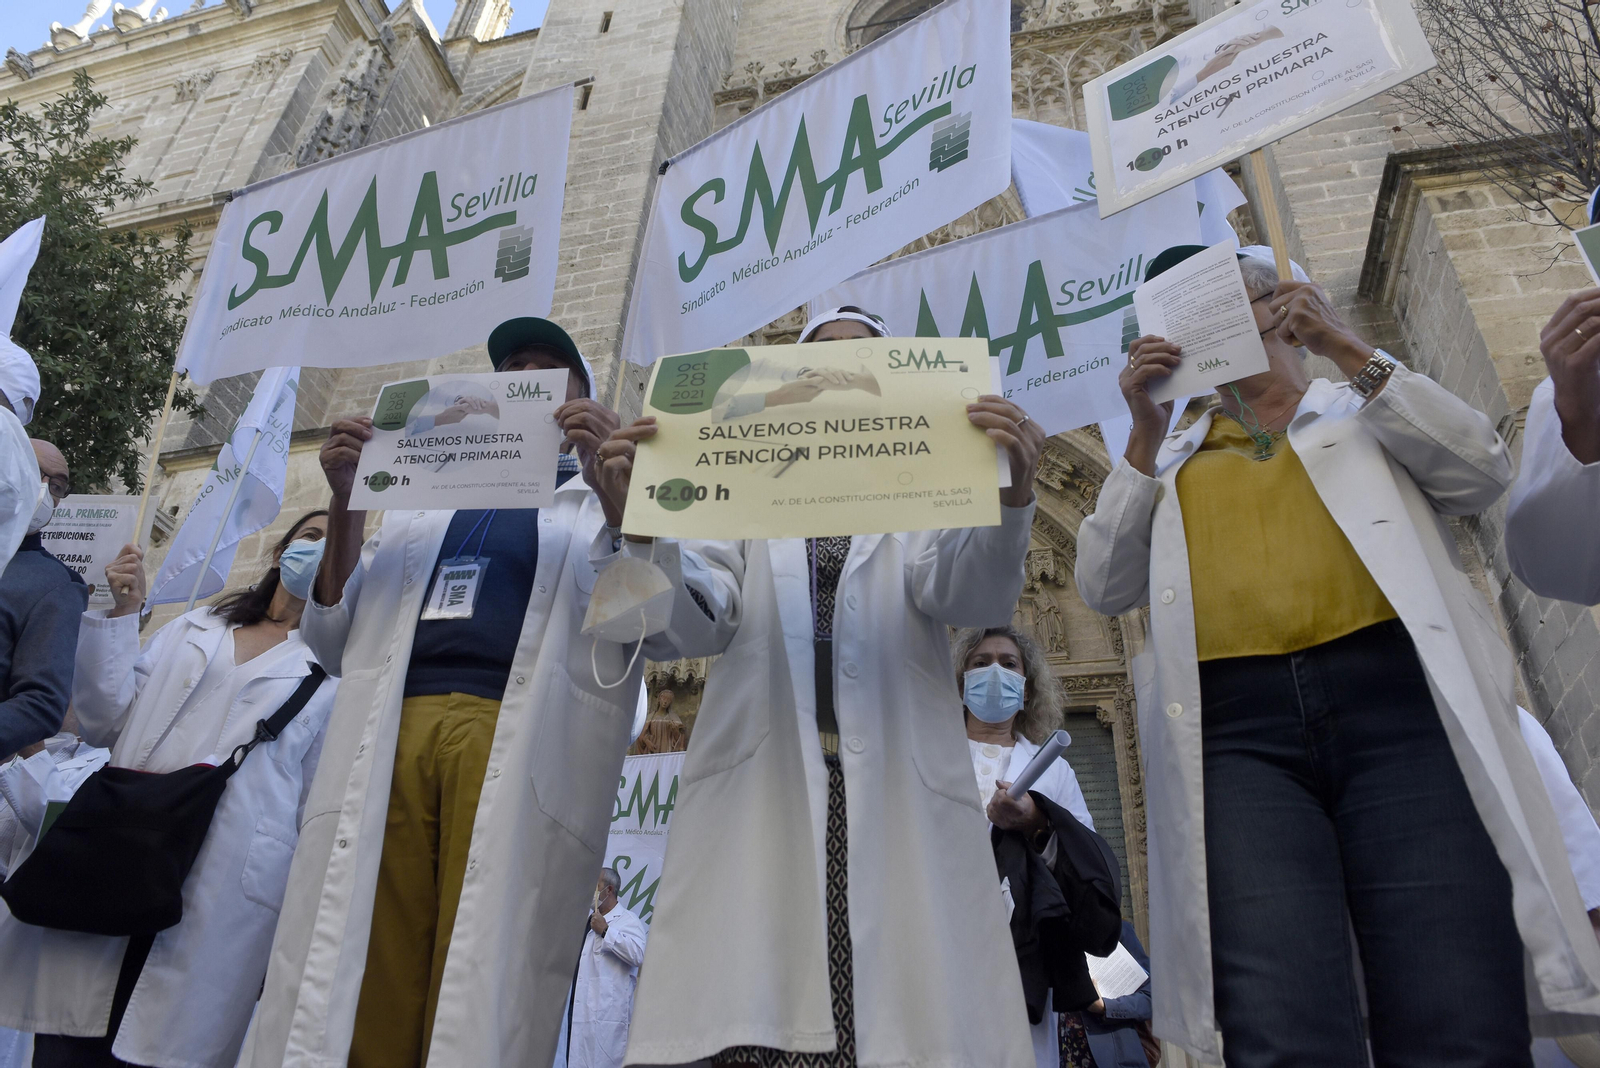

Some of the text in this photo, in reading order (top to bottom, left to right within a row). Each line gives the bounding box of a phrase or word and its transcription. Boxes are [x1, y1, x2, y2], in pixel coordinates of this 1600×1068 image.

[1123, 75, 1146, 91] Oct
[1154, 32, 1328, 124] SALVEMOS NUESTRA
[1344, 65, 1376, 83] SEVILLA
[879, 63, 977, 138] Sevilla
[1124, 83, 1148, 101] 28
[1157, 46, 1333, 138] ATENCIÓN PRIMARIA
[1233, 120, 1243, 129] DE
[1244, 115, 1254, 124] LA
[1255, 90, 1310, 118] CONSTITUCION
[1311, 73, 1343, 94] (FRENTE
[1344, 67, 1356, 75] AL
[1126, 94, 1151, 110] 2021
[1126, 138, 1188, 172] 12.00 h
[446, 171, 538, 223] Sevilla
[677, 93, 884, 283] SMA
[227, 170, 450, 310] SMA
[680, 279, 726, 315] Sindicato
[732, 253, 779, 285] Médico
[783, 228, 834, 263] Andaluz
[845, 177, 920, 229] Federación
[220, 312, 273, 341] Sindicato
[279, 302, 335, 320] Médico
[338, 301, 397, 318] Andaluz
[410, 279, 485, 308] Federación
[678, 361, 709, 373] Oct
[888, 347, 947, 371] SMA
[1197, 357, 1221, 372] SMA
[674, 373, 706, 388] 28
[1027, 356, 1110, 391] Federación
[507, 381, 540, 399] SMA
[671, 390, 704, 400] 2021
[386, 400, 404, 411] 28
[383, 411, 402, 420] 2021
[698, 415, 930, 440] SALVEMOS NUESTRA
[397, 433, 523, 449] SALVEMOS NUESTRA
[393, 449, 522, 465] ATENCIÓN PRIMARIA
[695, 441, 931, 467] ATENCIÓN PRIMARIA
[362, 475, 410, 486] 12.00 h
[645, 484, 730, 502] 12.00 h
[804, 497, 817, 505] LA
[818, 493, 890, 504] CONSTITUCION
[892, 490, 934, 501] (FRENTE
[950, 487, 972, 496] SAS)
[933, 498, 973, 508] SEVILLA
[76, 508, 119, 519] PRIMERO:
[446, 584, 467, 607] SMA
